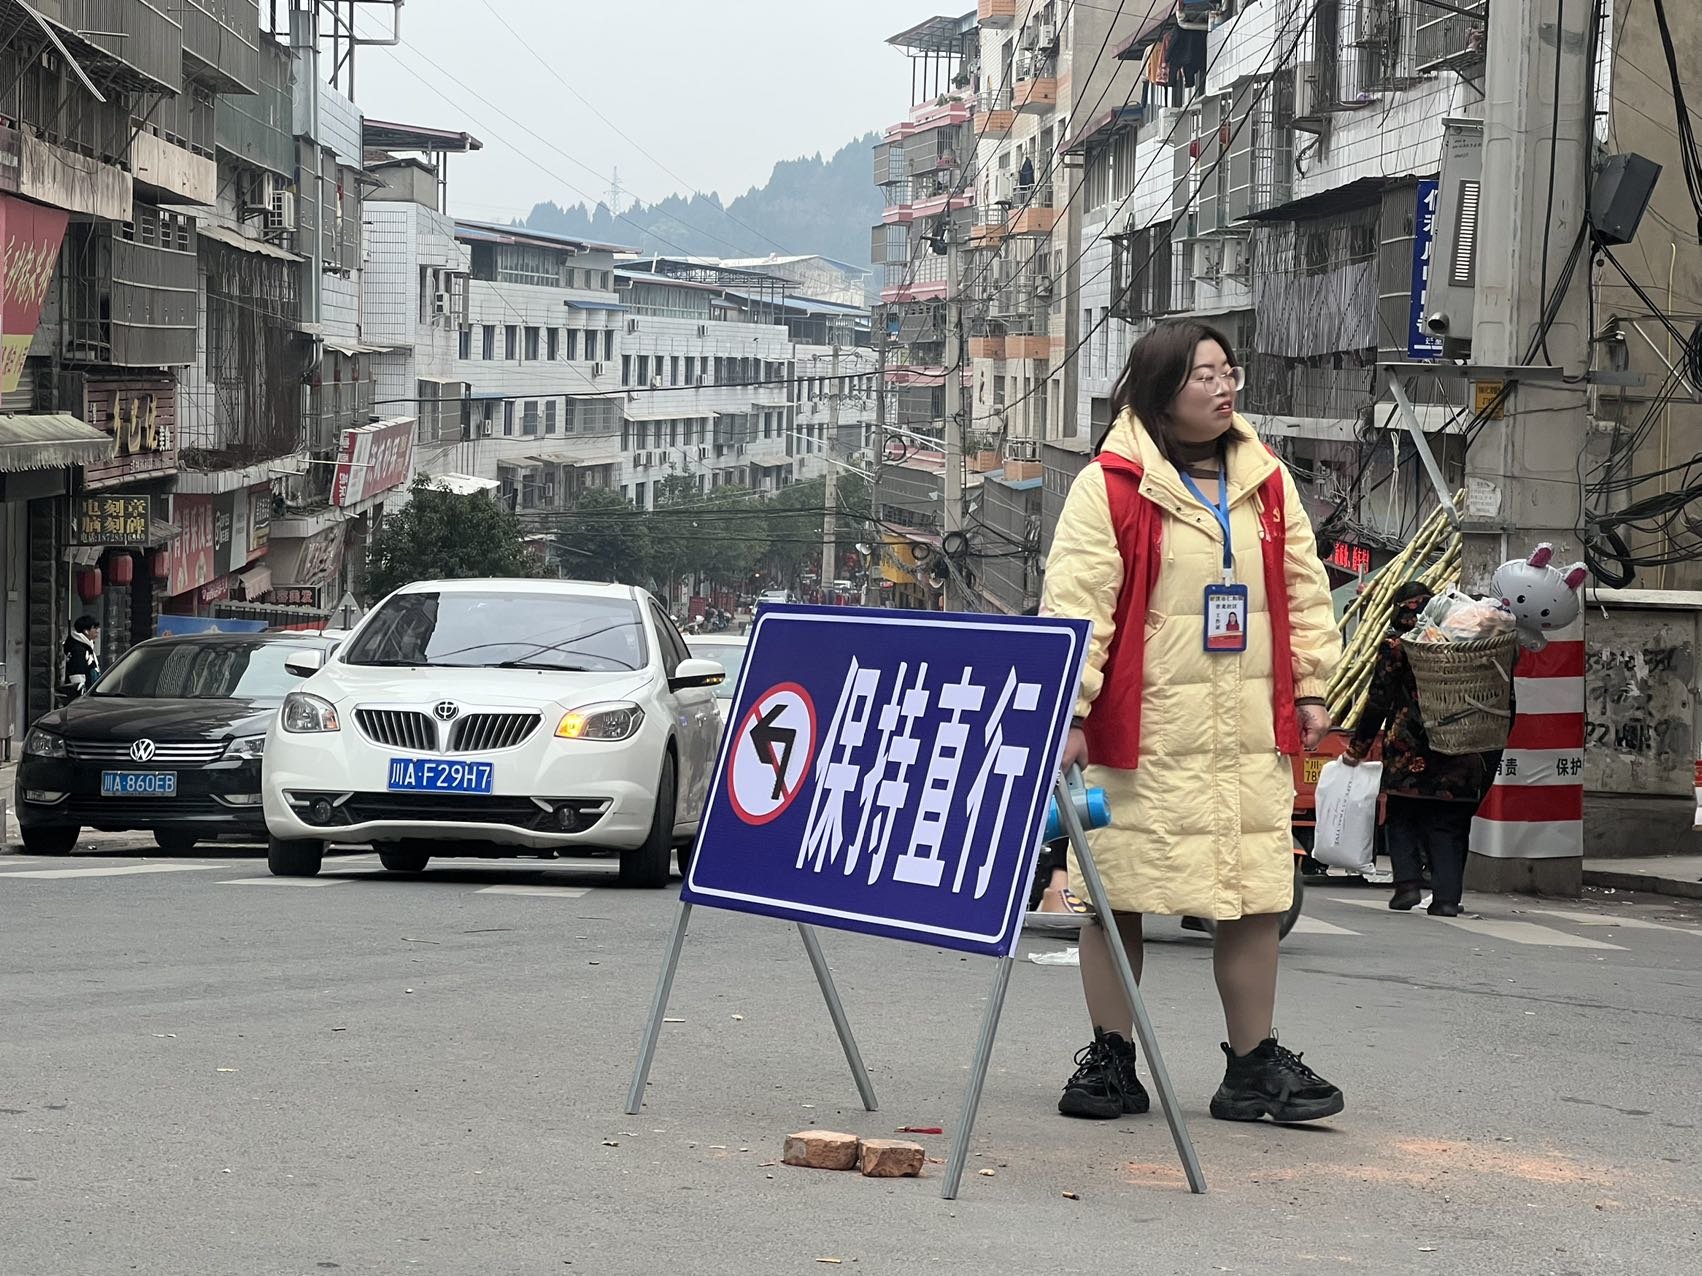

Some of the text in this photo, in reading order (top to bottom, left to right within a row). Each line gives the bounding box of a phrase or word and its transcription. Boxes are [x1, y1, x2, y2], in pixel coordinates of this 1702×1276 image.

[796, 655, 1042, 900] 保持直行
[1556, 757, 1582, 777] 保护
